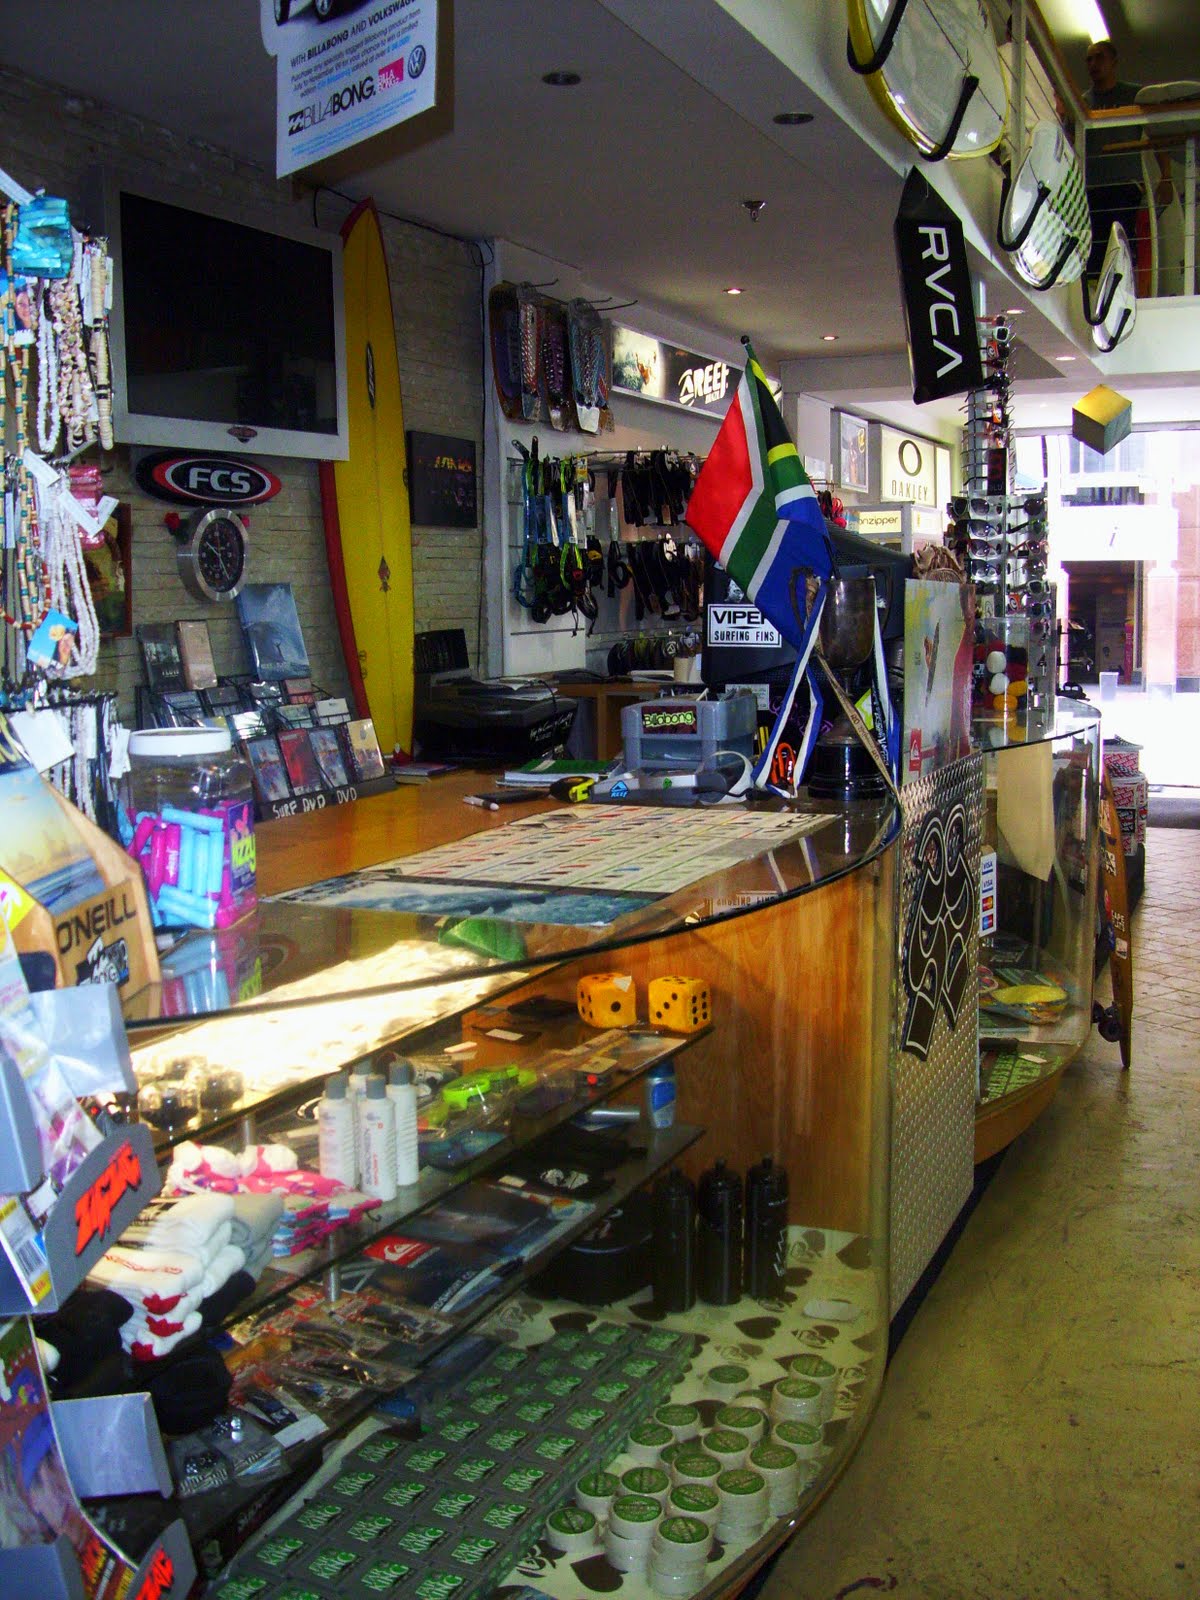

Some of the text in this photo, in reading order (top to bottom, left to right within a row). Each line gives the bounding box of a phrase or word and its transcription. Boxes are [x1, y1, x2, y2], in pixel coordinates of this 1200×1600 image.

[290, 0, 415, 67] WITH BILLABONG AND VOLKSWAG
[302, 76, 375, 130] BILLABONG
[188, 466, 250, 494] FCS
[891, 479, 929, 502] OAKLEY
[859, 515, 899, 526] onzipper
[712, 609, 766, 625] VIPE
[714, 630, 775, 642] SURFING FINS
[272, 786, 358, 820] SURF DVD DVD
[982, 861, 994, 870] VISA
[982, 879, 994, 889] VISA
